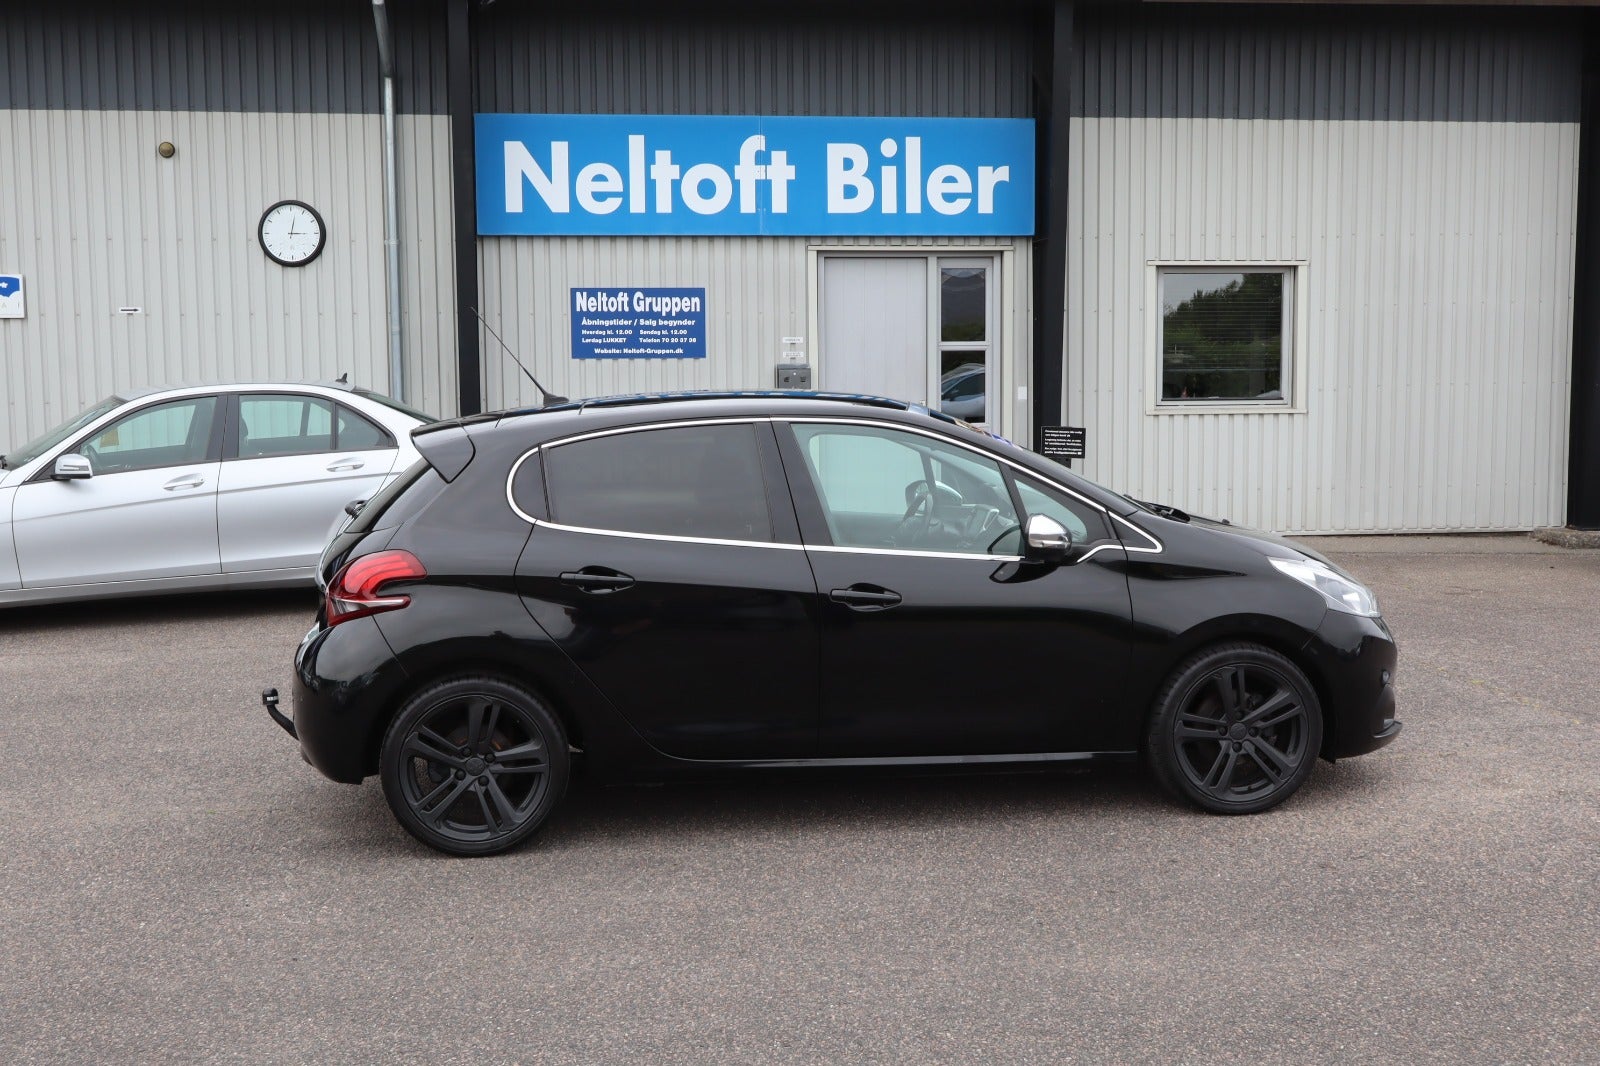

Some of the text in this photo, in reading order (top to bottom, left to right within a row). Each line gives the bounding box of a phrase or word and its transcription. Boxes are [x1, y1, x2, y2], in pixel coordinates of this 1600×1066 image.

[504, 134, 1010, 215] Neltoft Biler
[576, 291, 700, 317] Neltoft Gruppen
[581, 317, 632, 327] Åbningstider
[658, 318, 696, 327] begynder
